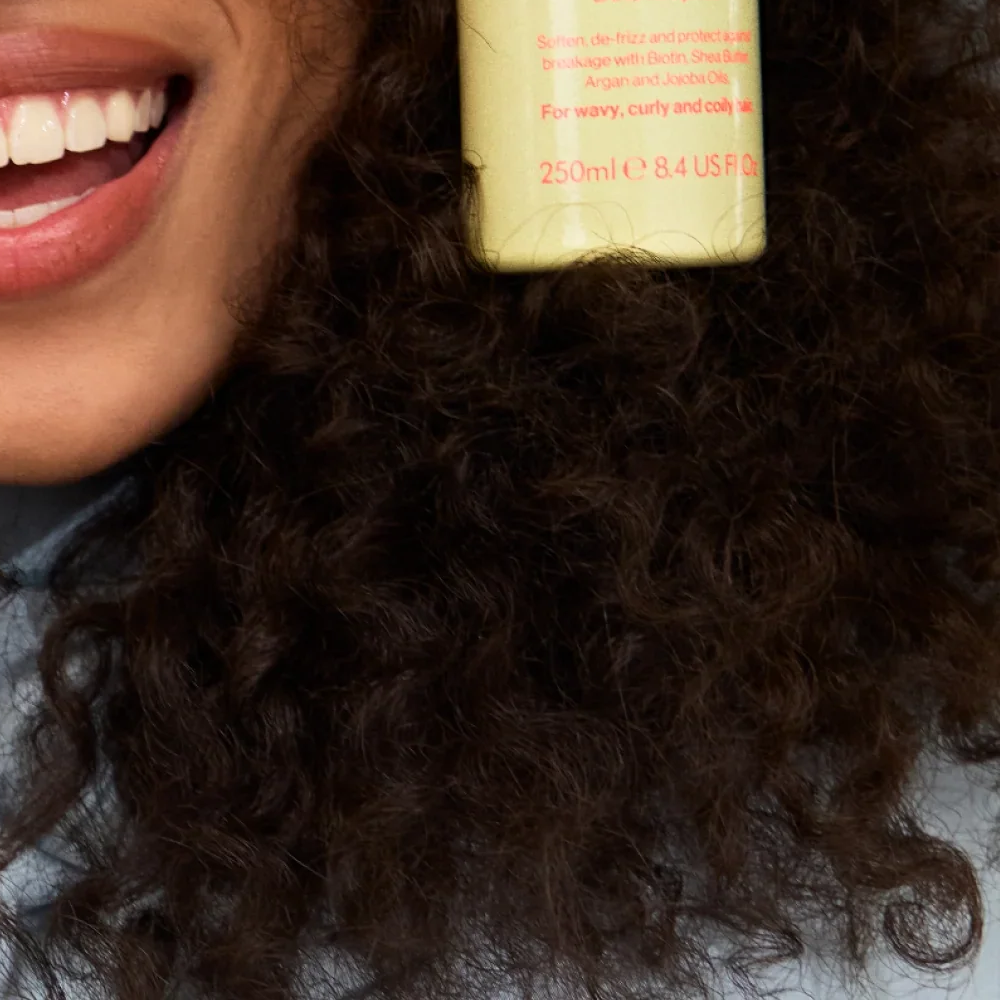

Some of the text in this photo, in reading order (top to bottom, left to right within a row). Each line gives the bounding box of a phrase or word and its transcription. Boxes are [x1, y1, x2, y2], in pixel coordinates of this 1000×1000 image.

[536, 33, 589, 50] Soften,
[590, 31, 647, 47] de-frizz
[649, 29, 676, 45] and
[677, 28, 722, 45] protect
[542, 55, 613, 72] breakage
[613, 52, 646, 67] with
[647, 49, 689, 66] Biotin,
[691, 49, 722, 64] Shea
[584, 74, 631, 91] Argan
[631, 73, 661, 88] and
[661, 71, 706, 87] Jojoba
[540, 103, 570, 121] For
[573, 104, 625, 121] wavy,
[627, 99, 670, 118] curly
[672, 97, 703, 115] and
[540, 157, 617, 185] 250ml
[653, 155, 688, 180] 8.4
[693, 153, 722, 178] US
